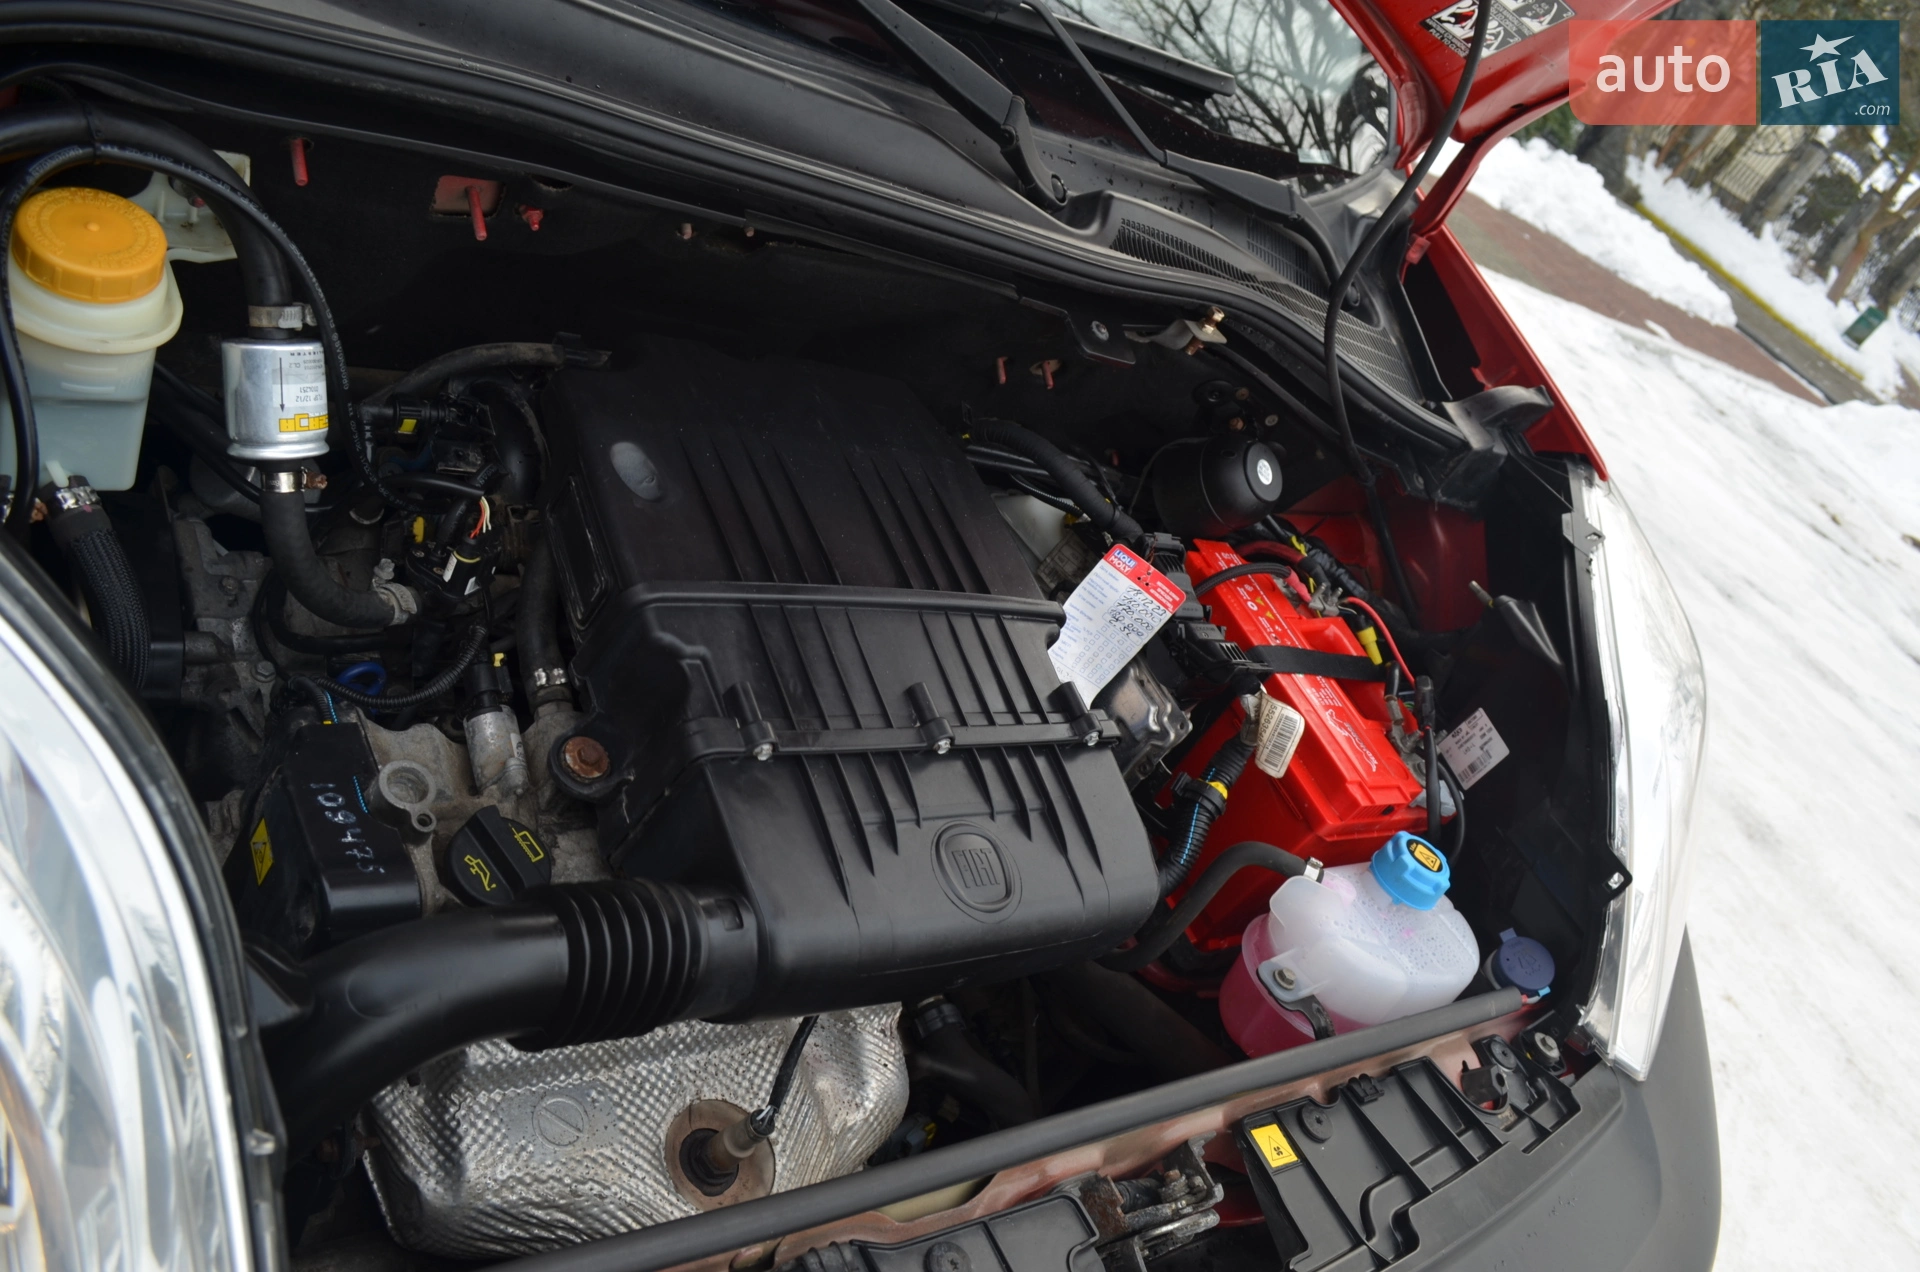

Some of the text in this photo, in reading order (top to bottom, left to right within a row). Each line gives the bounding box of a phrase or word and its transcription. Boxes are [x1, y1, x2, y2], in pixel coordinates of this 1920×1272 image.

[1109, 555, 1132, 574] MOLY
[1114, 548, 1137, 569] LIQUI
[951, 847, 1000, 889] FIAT
